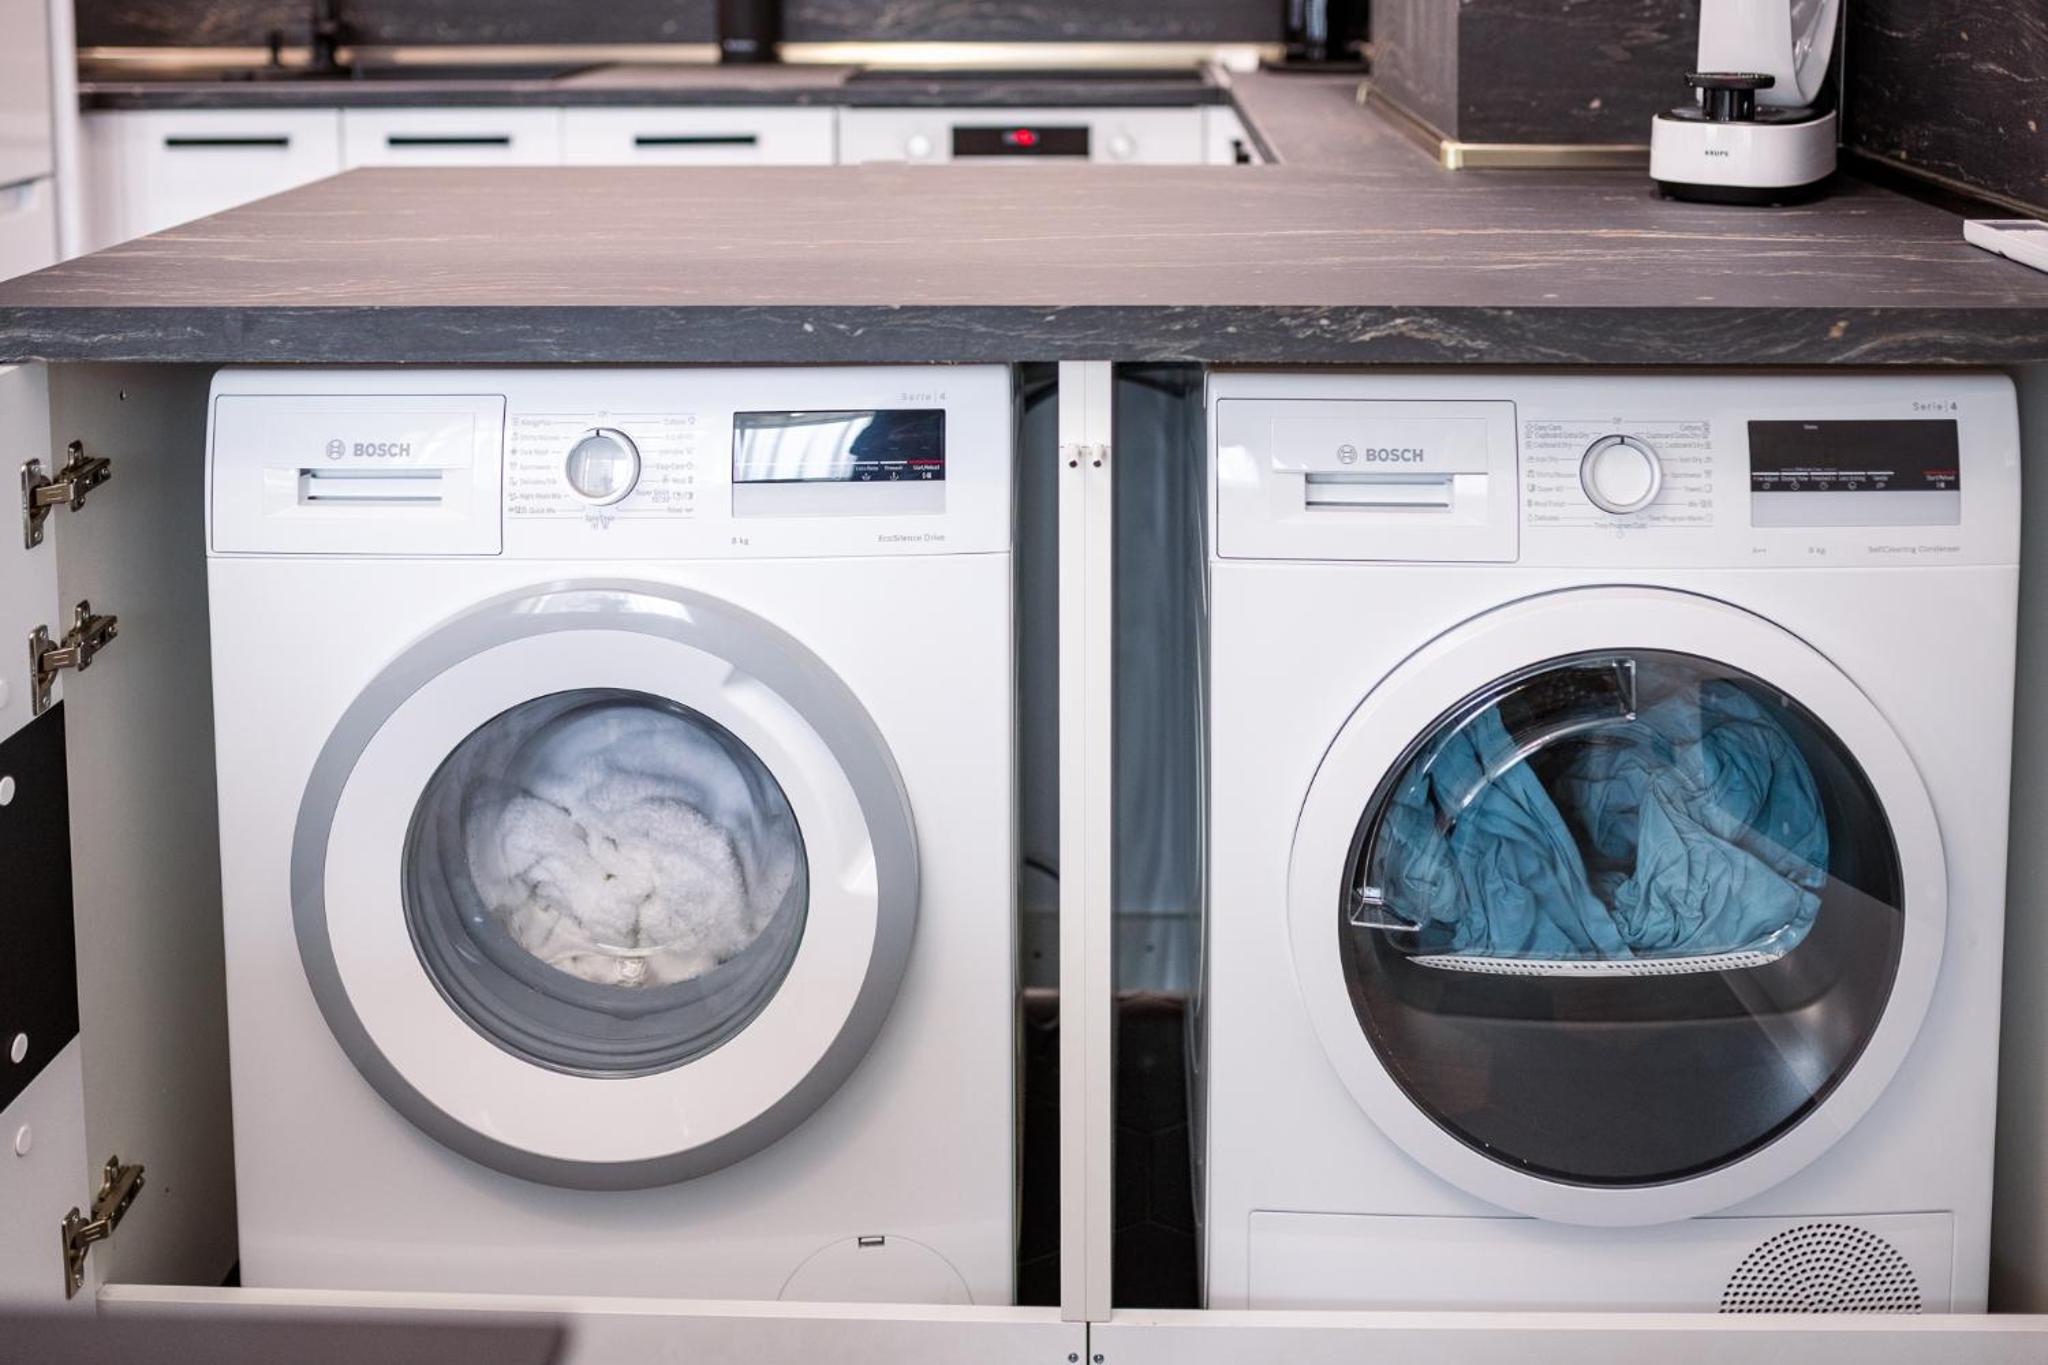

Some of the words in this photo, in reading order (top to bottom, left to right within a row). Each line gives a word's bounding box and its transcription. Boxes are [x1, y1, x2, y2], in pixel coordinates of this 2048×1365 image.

[1705, 150, 1729, 158] KRUPS
[354, 443, 409, 457] BOSCH
[1366, 448, 1423, 462] BOSCH
[924, 534, 945, 543] Drive
